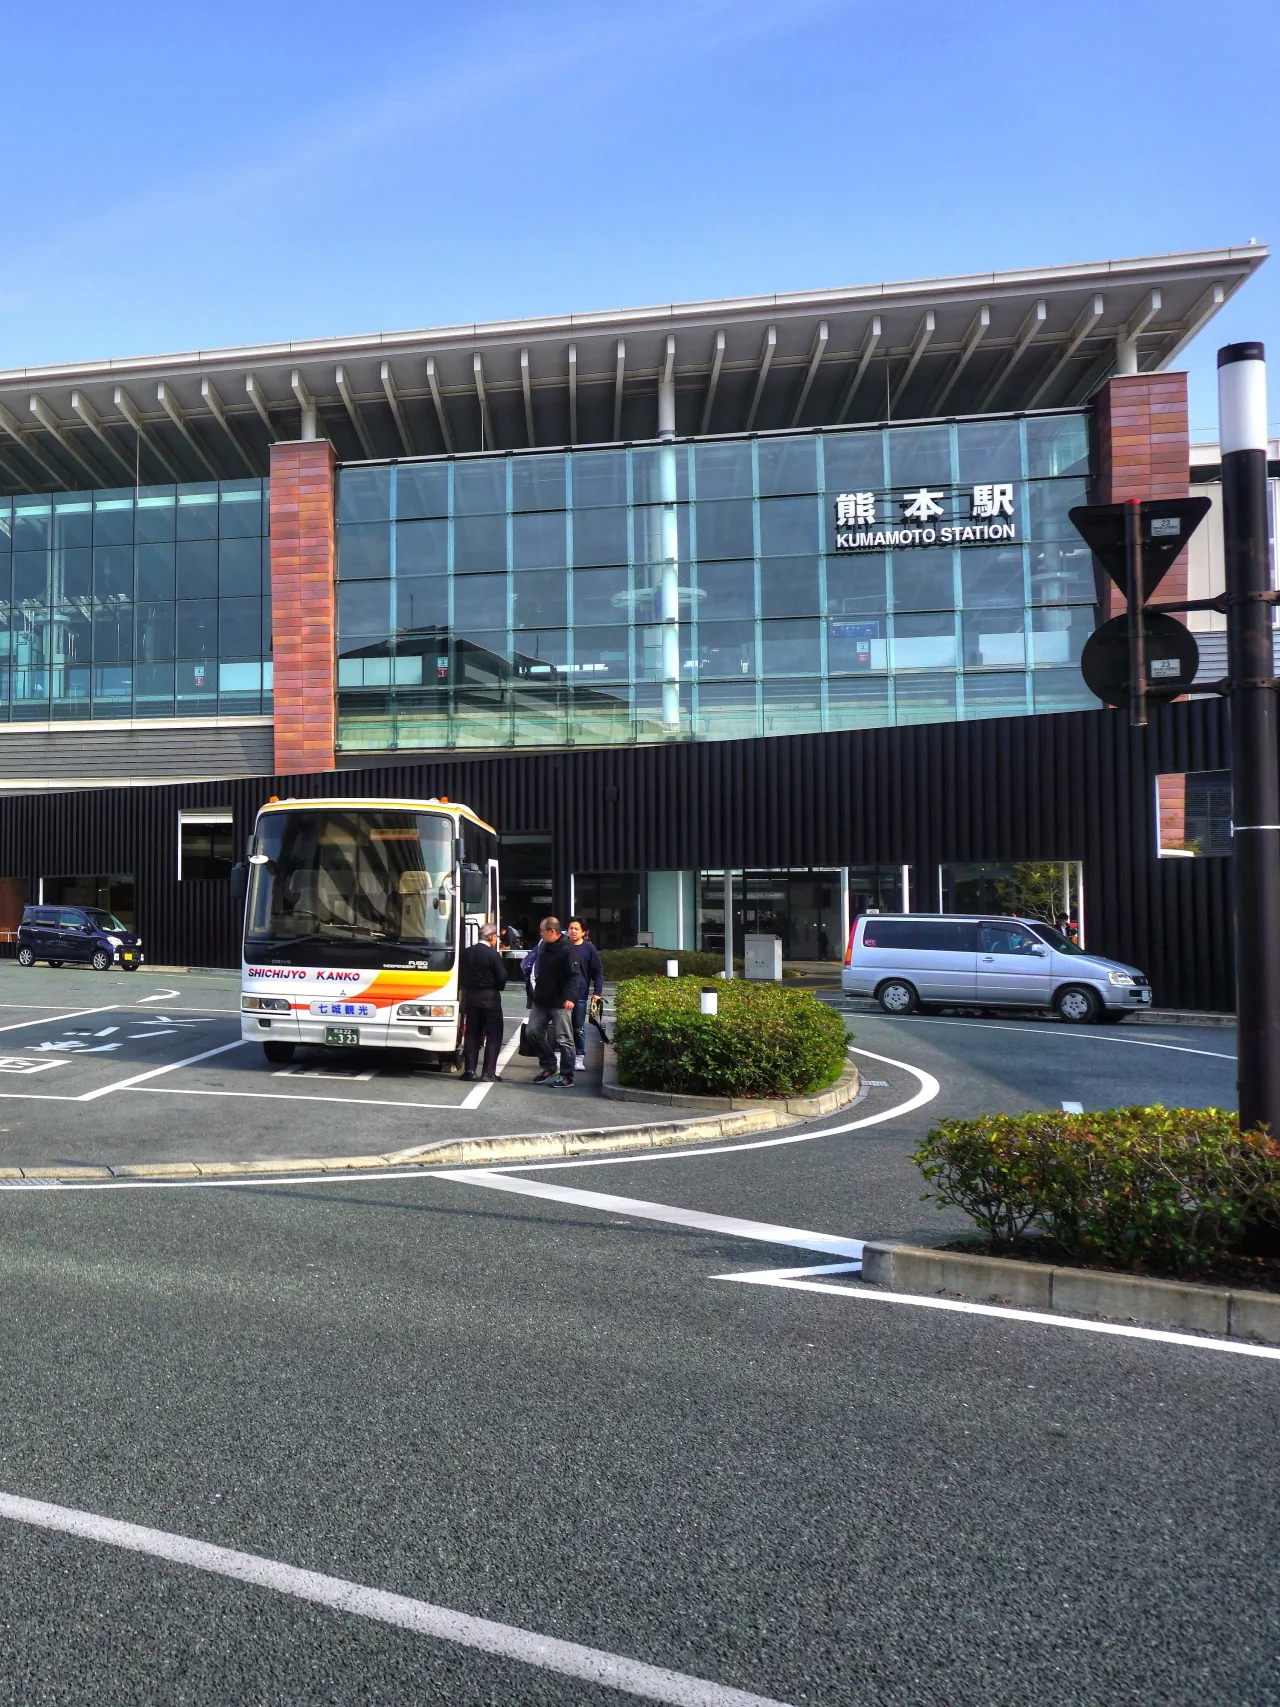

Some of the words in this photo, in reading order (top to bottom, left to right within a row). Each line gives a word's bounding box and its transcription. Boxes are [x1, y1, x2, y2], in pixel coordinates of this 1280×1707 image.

[836, 483, 1015, 526] 熊本駅
[1161, 519, 1171, 527] 23
[836, 528, 936, 548] KUMAMOTO
[940, 523, 1016, 542] STATION
[248, 968, 307, 980] SHICHIJYO
[316, 971, 361, 982] KANKO
[317, 1003, 369, 1016] 七城観光
